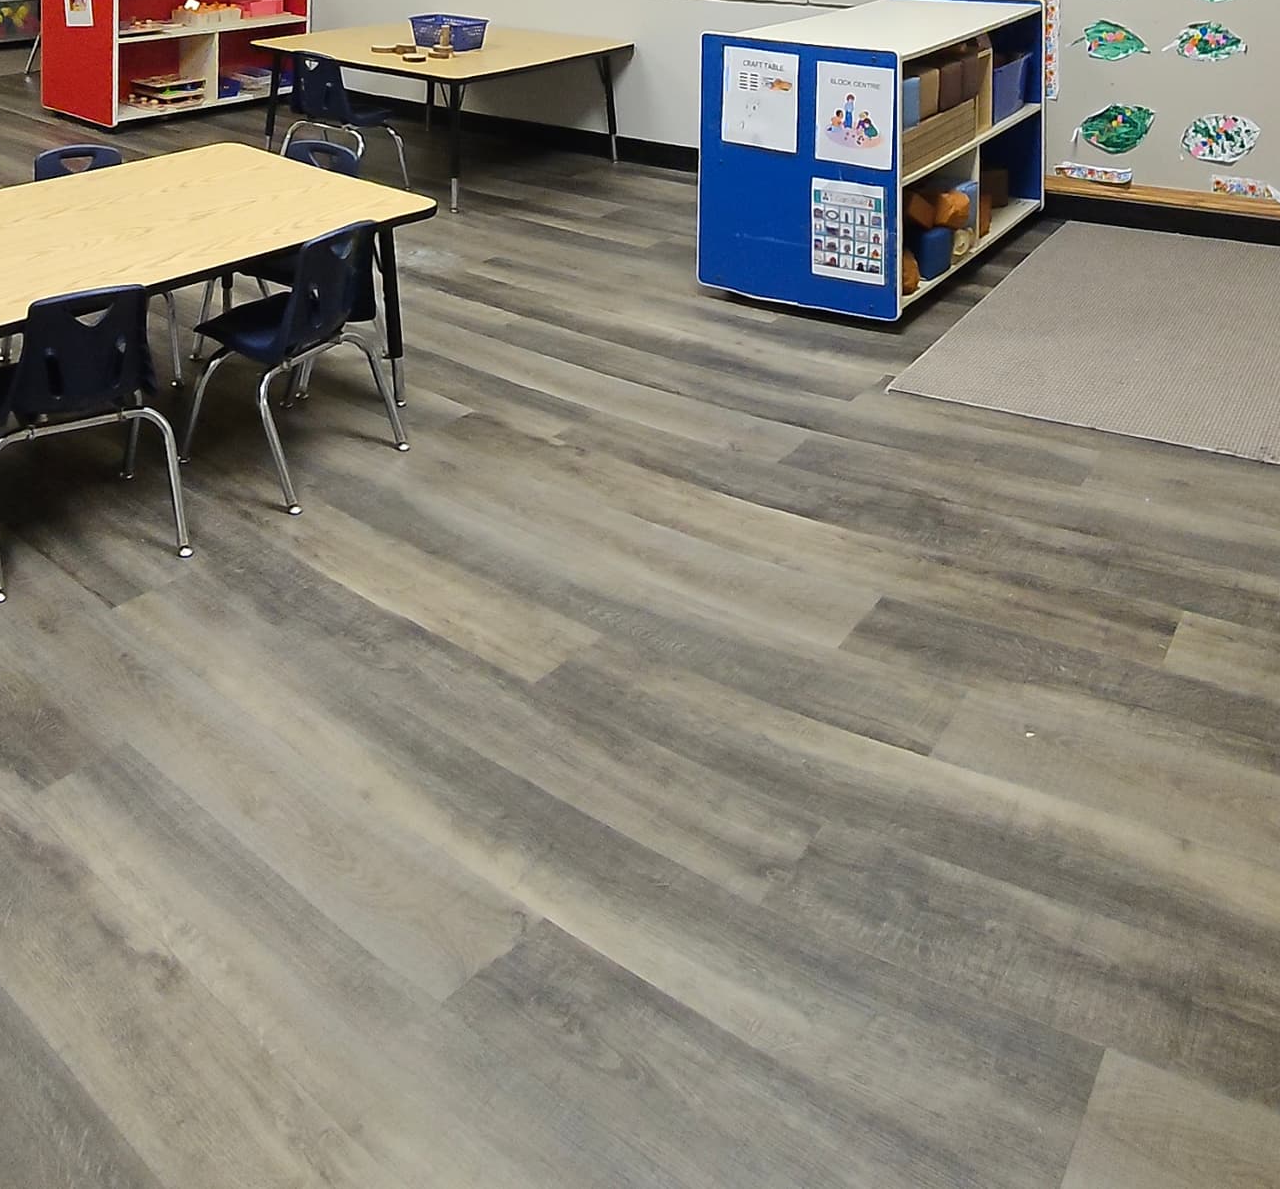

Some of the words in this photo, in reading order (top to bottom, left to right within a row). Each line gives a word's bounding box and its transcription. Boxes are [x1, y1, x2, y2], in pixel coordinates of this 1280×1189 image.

[743, 59, 763, 68] CRAFT
[764, 62, 784, 72] TABLE
[830, 78, 851, 86] BLOCK
